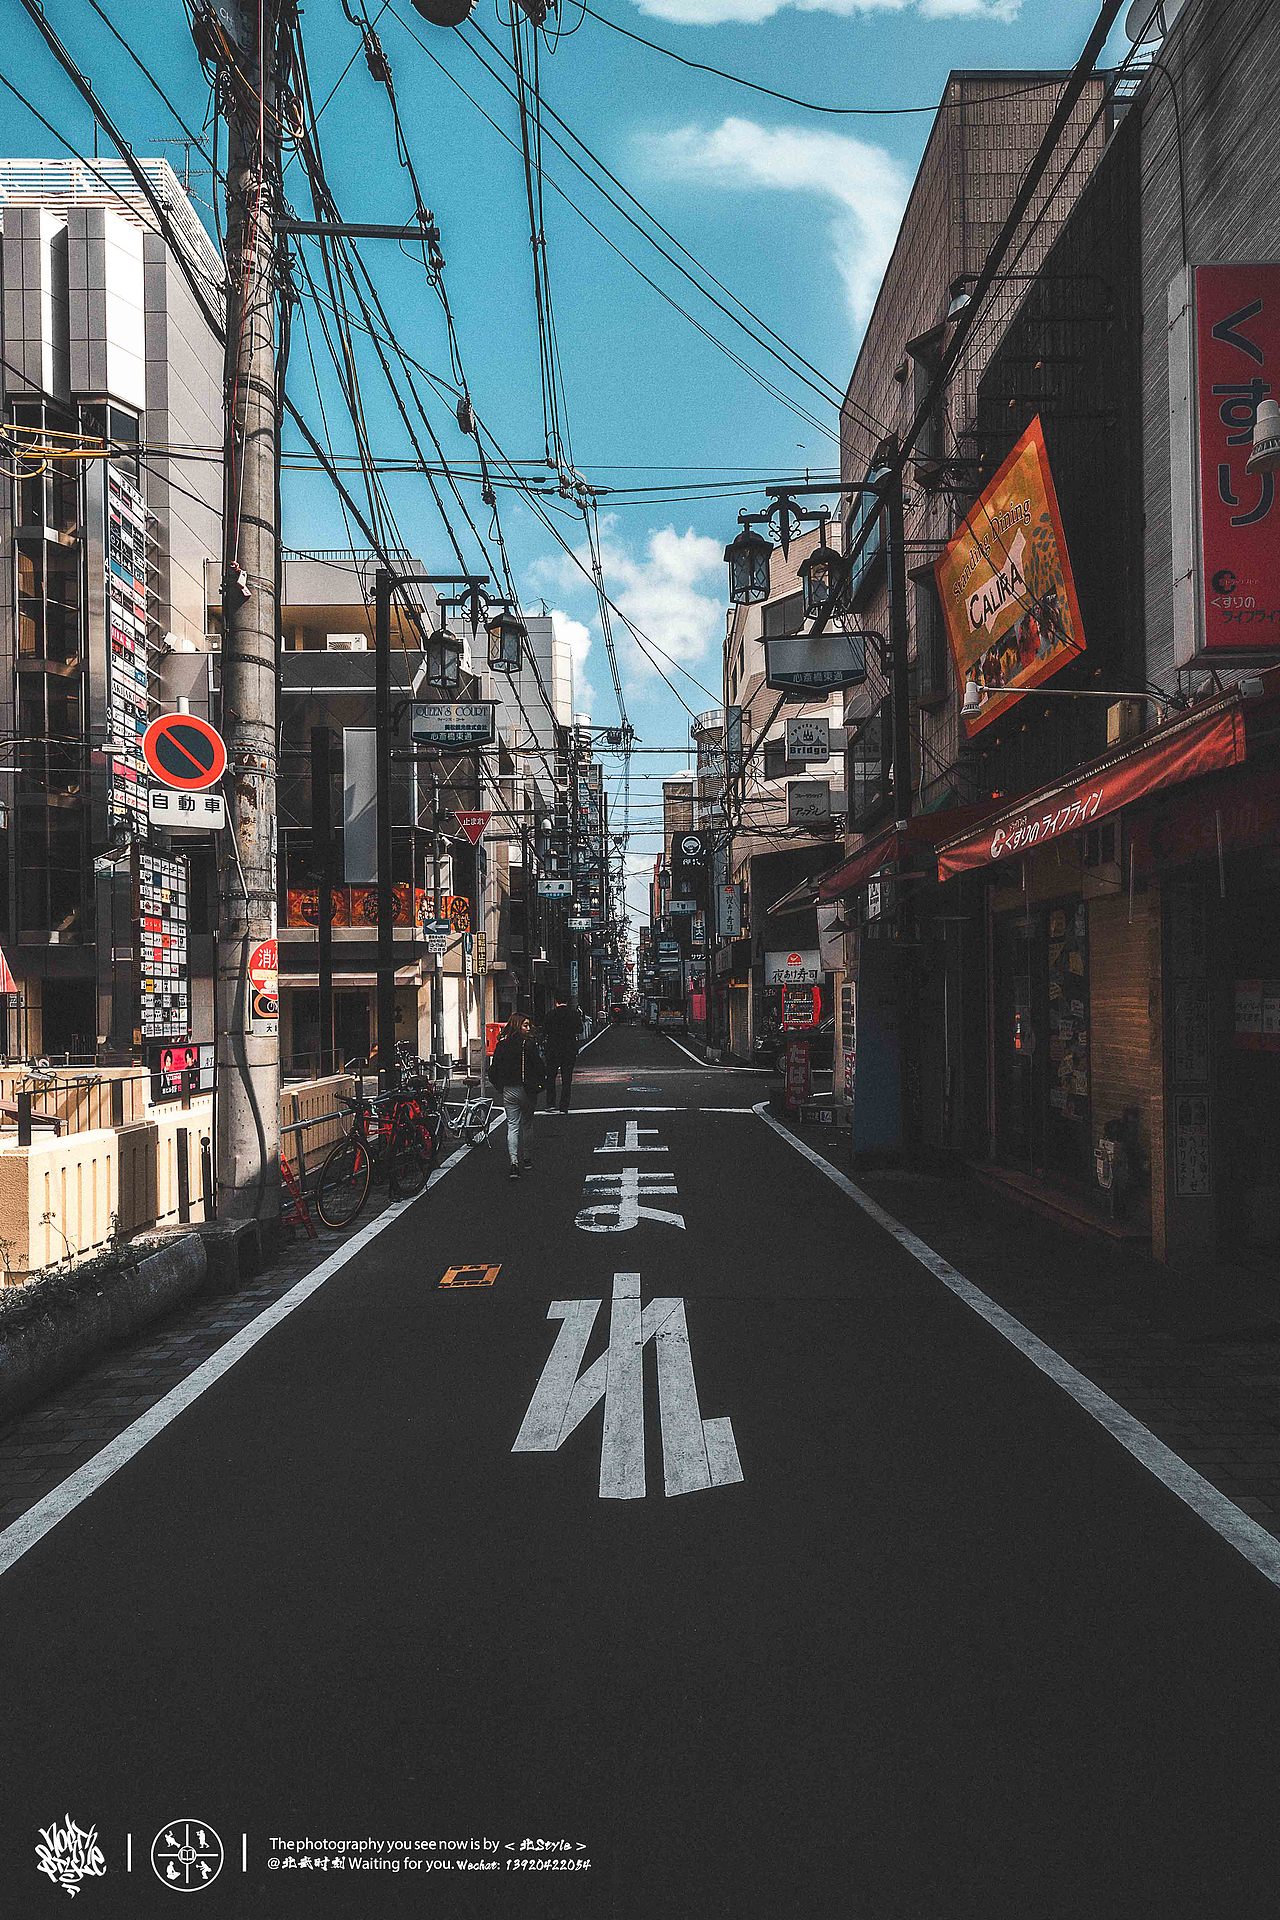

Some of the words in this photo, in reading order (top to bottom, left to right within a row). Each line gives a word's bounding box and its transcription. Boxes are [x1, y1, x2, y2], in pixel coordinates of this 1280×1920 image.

[1211, 298, 1275, 527] くすり
[1210, 595, 1256, 609] くすりの
[455, 705, 487, 717] COURT
[790, 746, 827, 756] Bridge
[152, 793, 222, 814] 自動車
[463, 817, 485, 826] 止まれ
[772, 967, 818, 984] 夜あけ寿司
[512, 1121, 745, 1500] 止まれ
